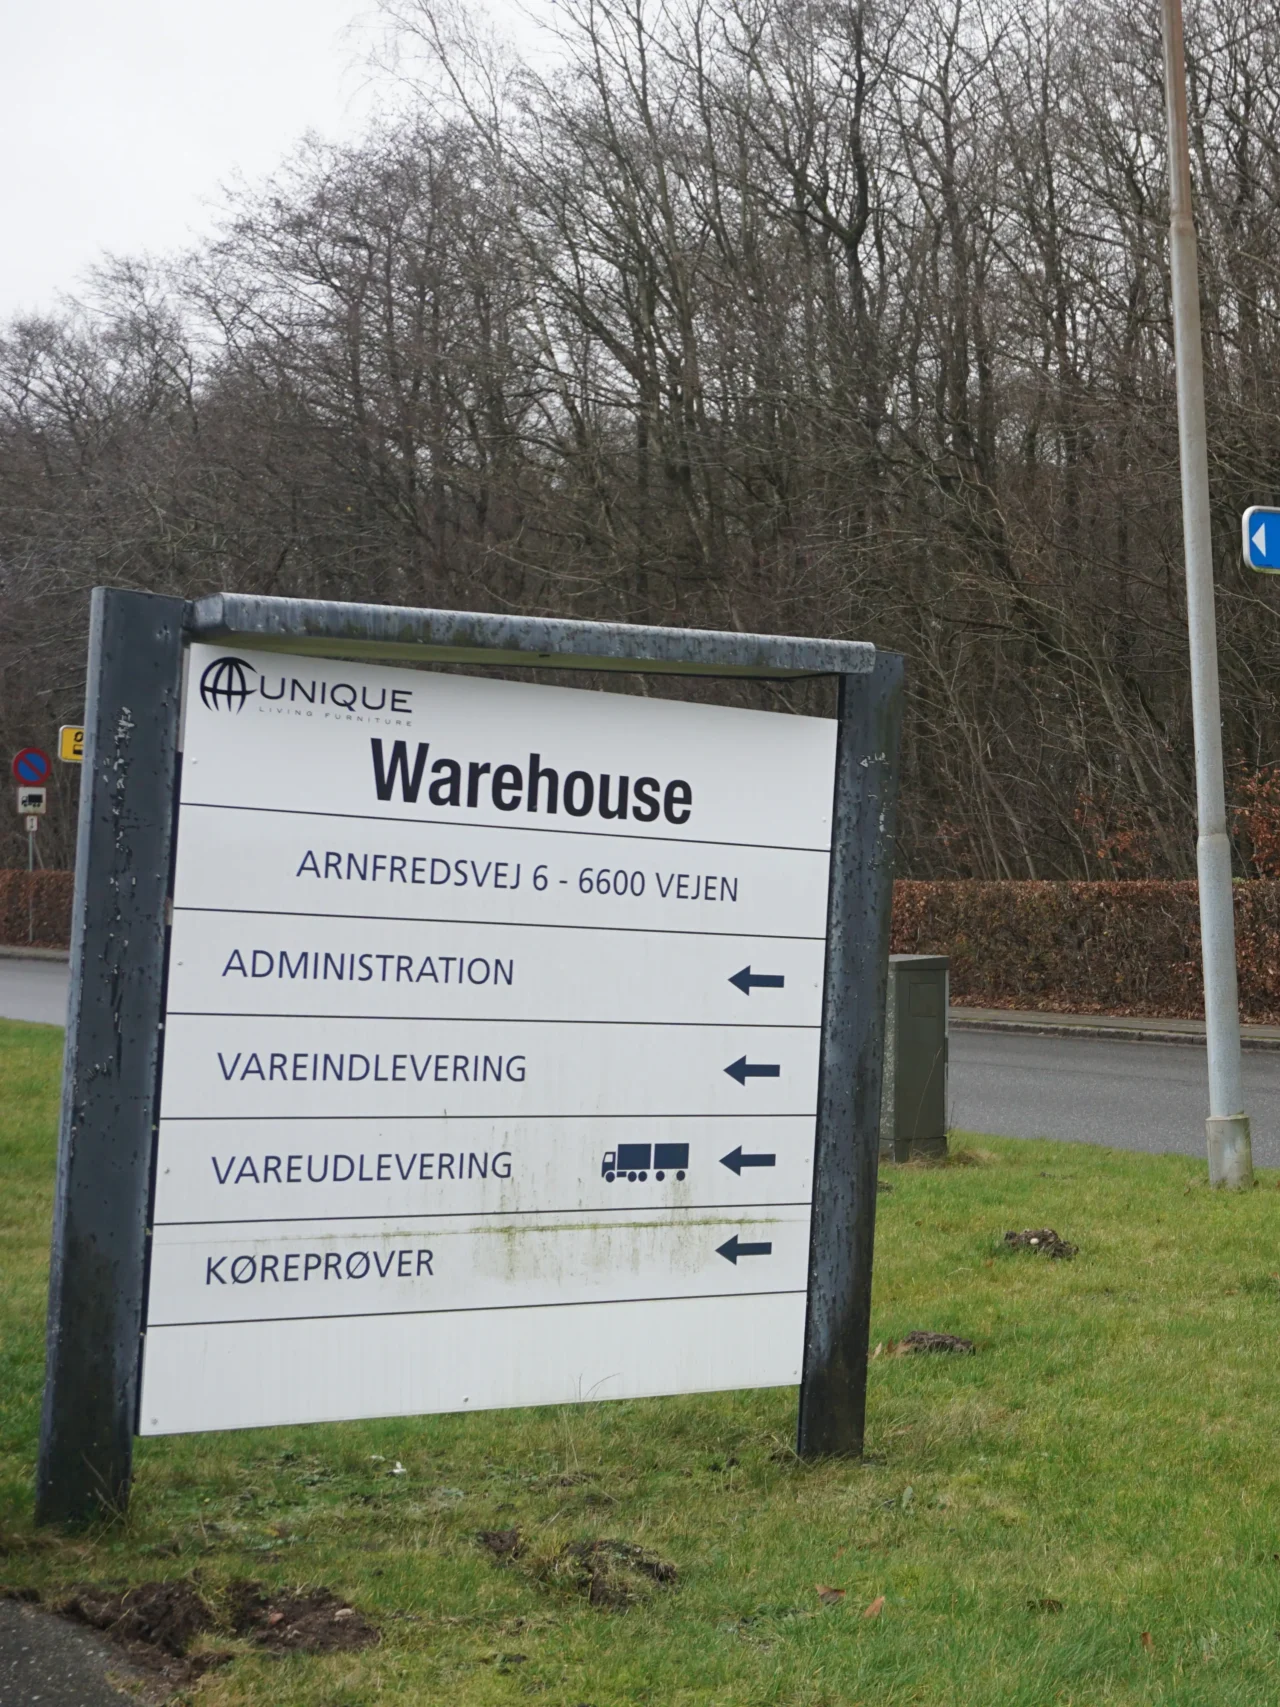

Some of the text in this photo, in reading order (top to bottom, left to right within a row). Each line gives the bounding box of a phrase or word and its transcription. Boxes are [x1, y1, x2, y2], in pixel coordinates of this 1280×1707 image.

[260, 674, 413, 713] UNIQUE
[258, 706, 413, 727] LIVING FURNITURE
[370, 737, 692, 825] Warehouse
[295, 850, 521, 890] ARNFREDSVEJ
[532, 863, 549, 892] 6
[577, 867, 646, 897] 6600
[655, 871, 739, 902] VEJEN
[221, 948, 515, 986] ADMINISTRATION
[217, 1052, 527, 1083] VAREINDLEVERING
[211, 1151, 513, 1185] VAREUDLEVERING
[205, 1249, 435, 1286] KØREPRØVER
